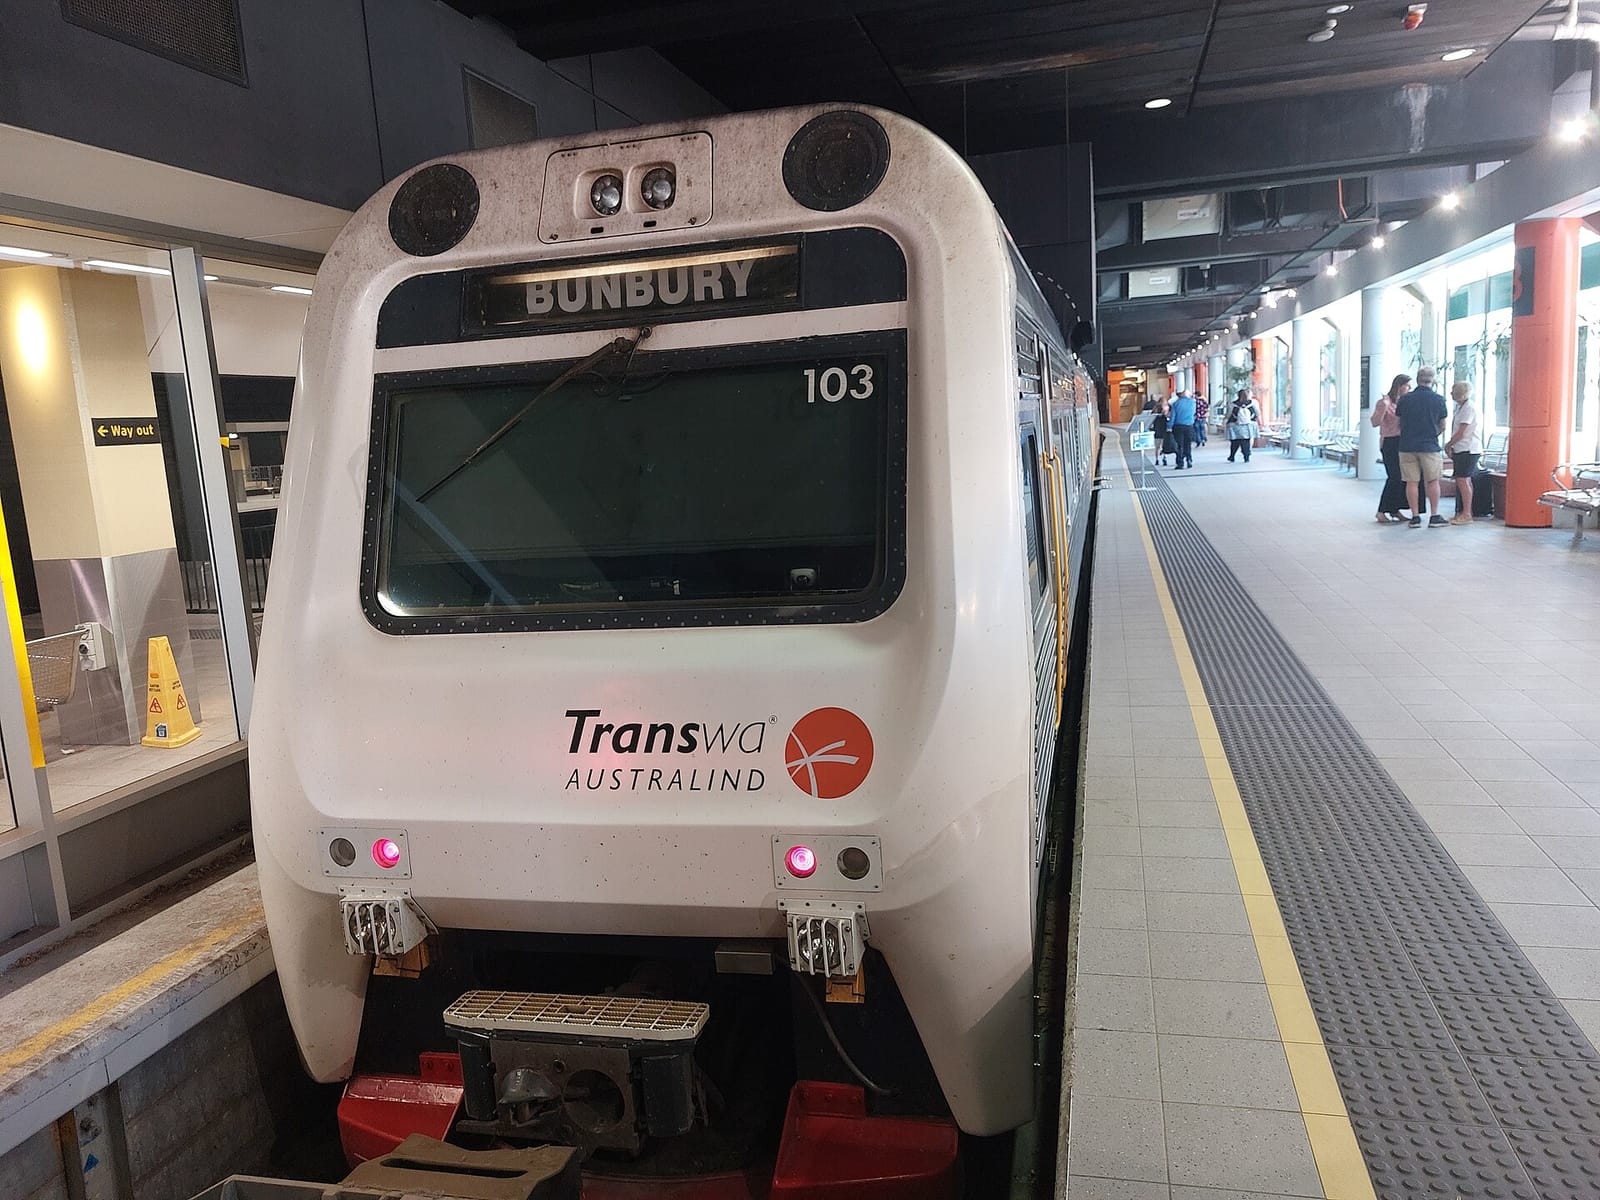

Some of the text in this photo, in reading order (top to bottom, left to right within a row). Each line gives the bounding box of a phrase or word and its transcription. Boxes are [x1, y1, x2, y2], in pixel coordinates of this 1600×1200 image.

[526, 261, 755, 314] BUNBURY
[803, 364, 874, 404] 103
[110, 424, 154, 438] Way out
[565, 768, 766, 791] AUSTRALIND
